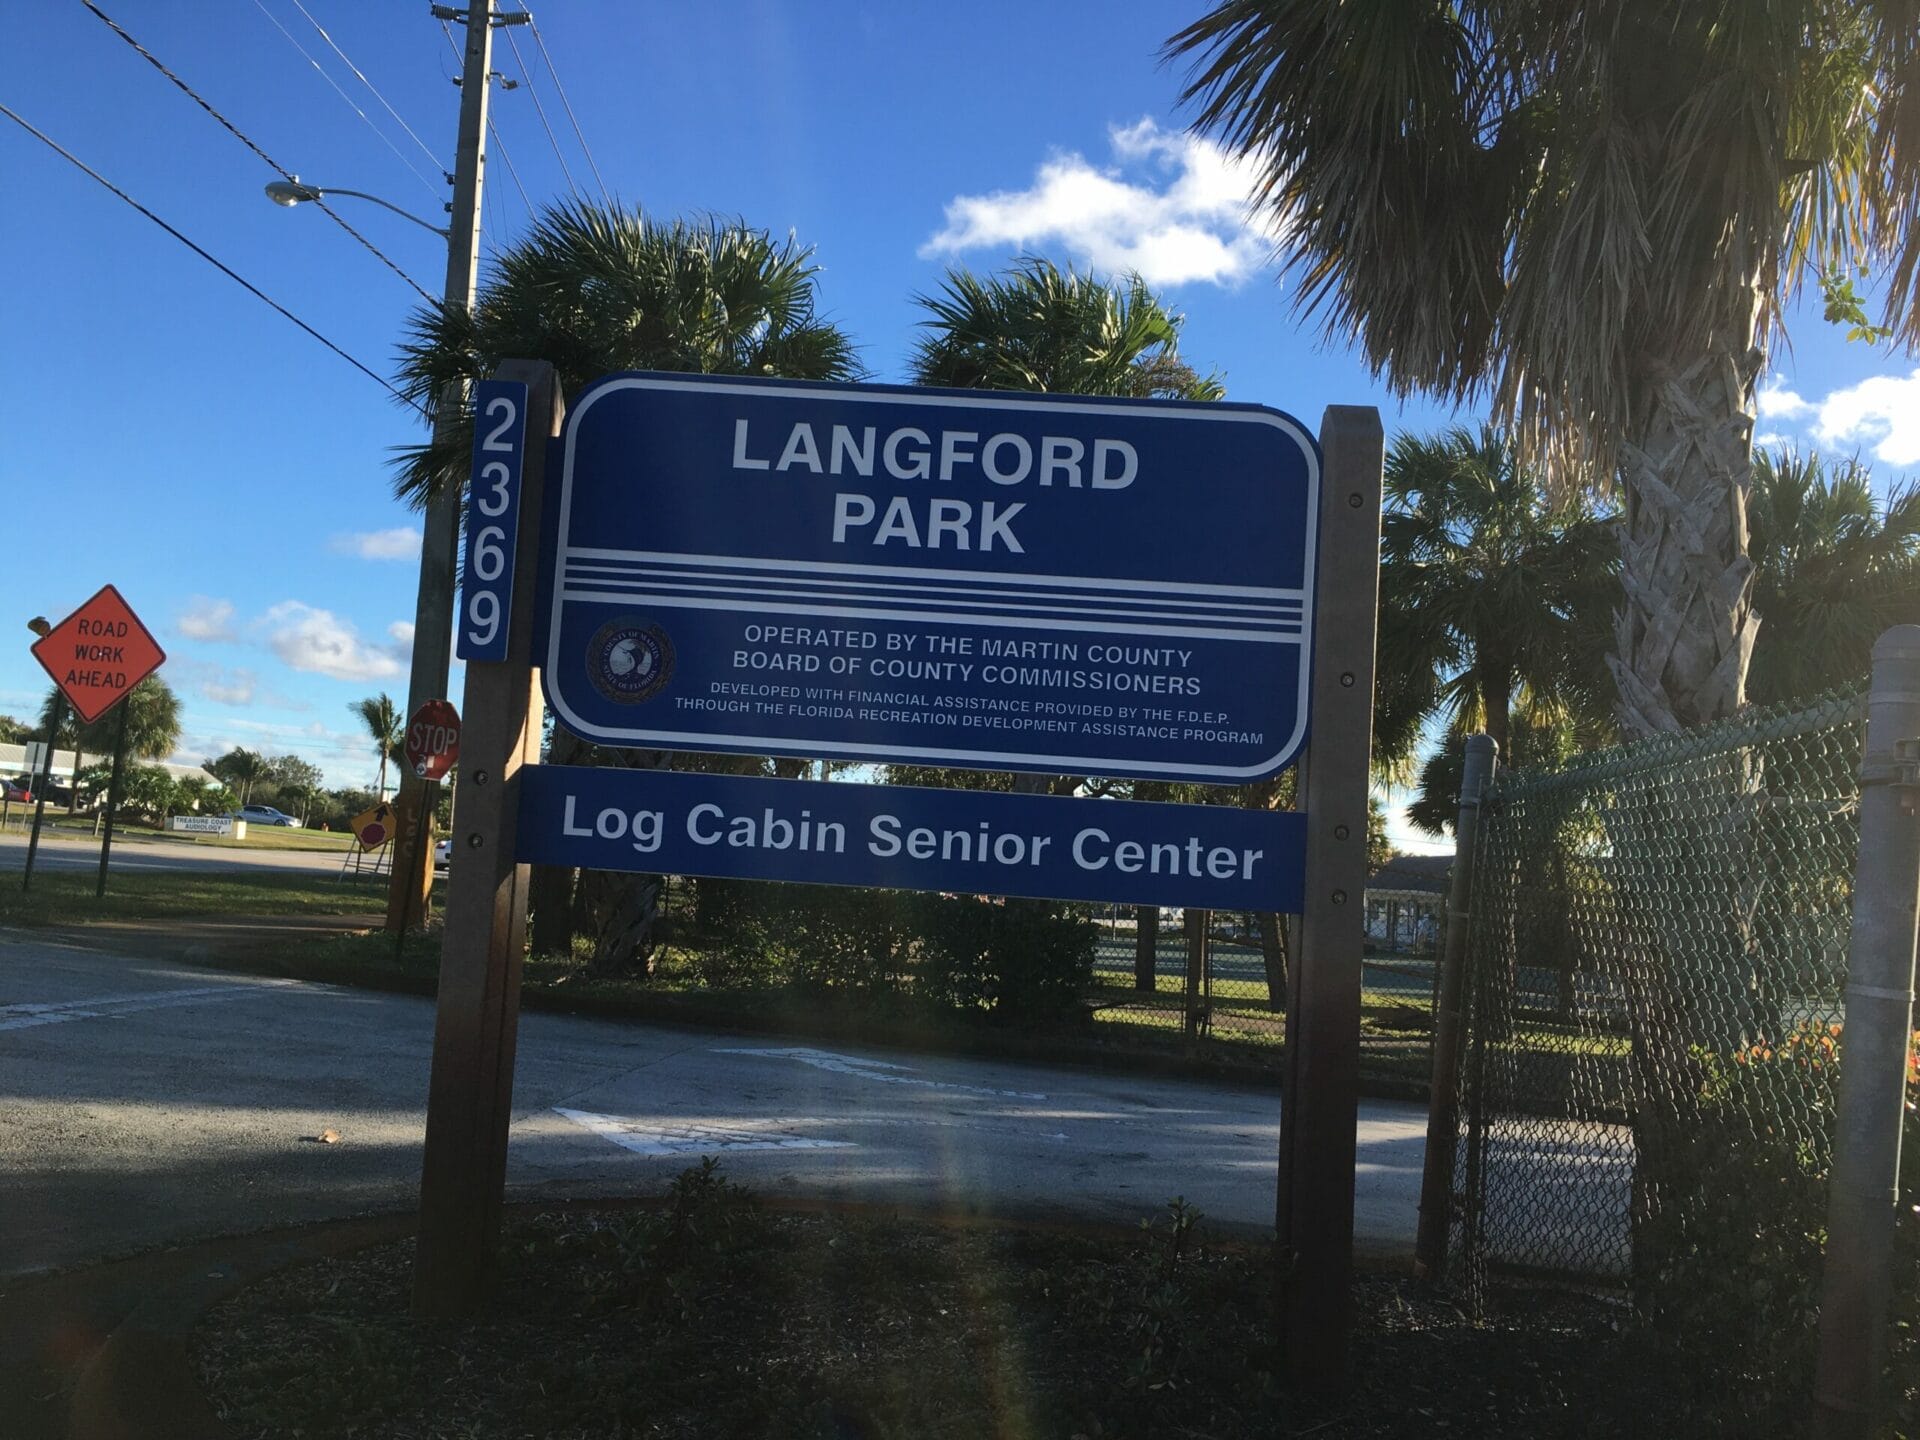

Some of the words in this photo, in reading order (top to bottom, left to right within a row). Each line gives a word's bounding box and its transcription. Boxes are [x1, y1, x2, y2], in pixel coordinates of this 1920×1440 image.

[732, 419, 1138, 490] LANGFORD
[470, 399, 516, 645] 2369
[832, 493, 1026, 554] PARK
[78, 619, 128, 638] ROAD
[744, 625, 877, 649] OPERATED
[886, 633, 917, 650] BY
[925, 635, 973, 655] THE
[982, 639, 1078, 661] MARTIN
[1087, 645, 1192, 668] COUNTY
[75, 644, 124, 663] WORK
[733, 650, 820, 672] BOARD
[829, 657, 862, 675] OF
[870, 658, 974, 682] COUNTY
[982, 665, 1201, 695] COMMISSIONERS
[64, 669, 127, 689] AHEAD
[675, 697, 750, 713] THROUGH
[755, 702, 784, 715] THE
[789, 704, 854, 719] FLORIDA
[859, 709, 957, 726] RECREATION
[962, 715, 1077, 733] DEVELOPMENT
[1081, 723, 1178, 739] ASSISTANCE
[1183, 729, 1264, 744] PROGRAM
[710, 682, 800, 698] DEVELOPED
[805, 688, 843, 700] WITH
[848, 690, 929, 706] FINANCIAL
[933, 696, 1028, 712] ASSISTANCE
[1035, 702, 1113, 717] PROVIDED
[1118, 707, 1137, 718] BY
[1142, 708, 1172, 721] THE
[1177, 710, 1231, 724] F.D.E.P.
[410, 723, 457, 755] STOP
[175, 817, 208, 825] TREASURE
[185, 823, 221, 831] AUDIOLOGY
[562, 795, 664, 853] Log
[687, 803, 846, 857] Cabin
[868, 814, 1052, 867] Senior
[1072, 827, 1264, 880] Center
